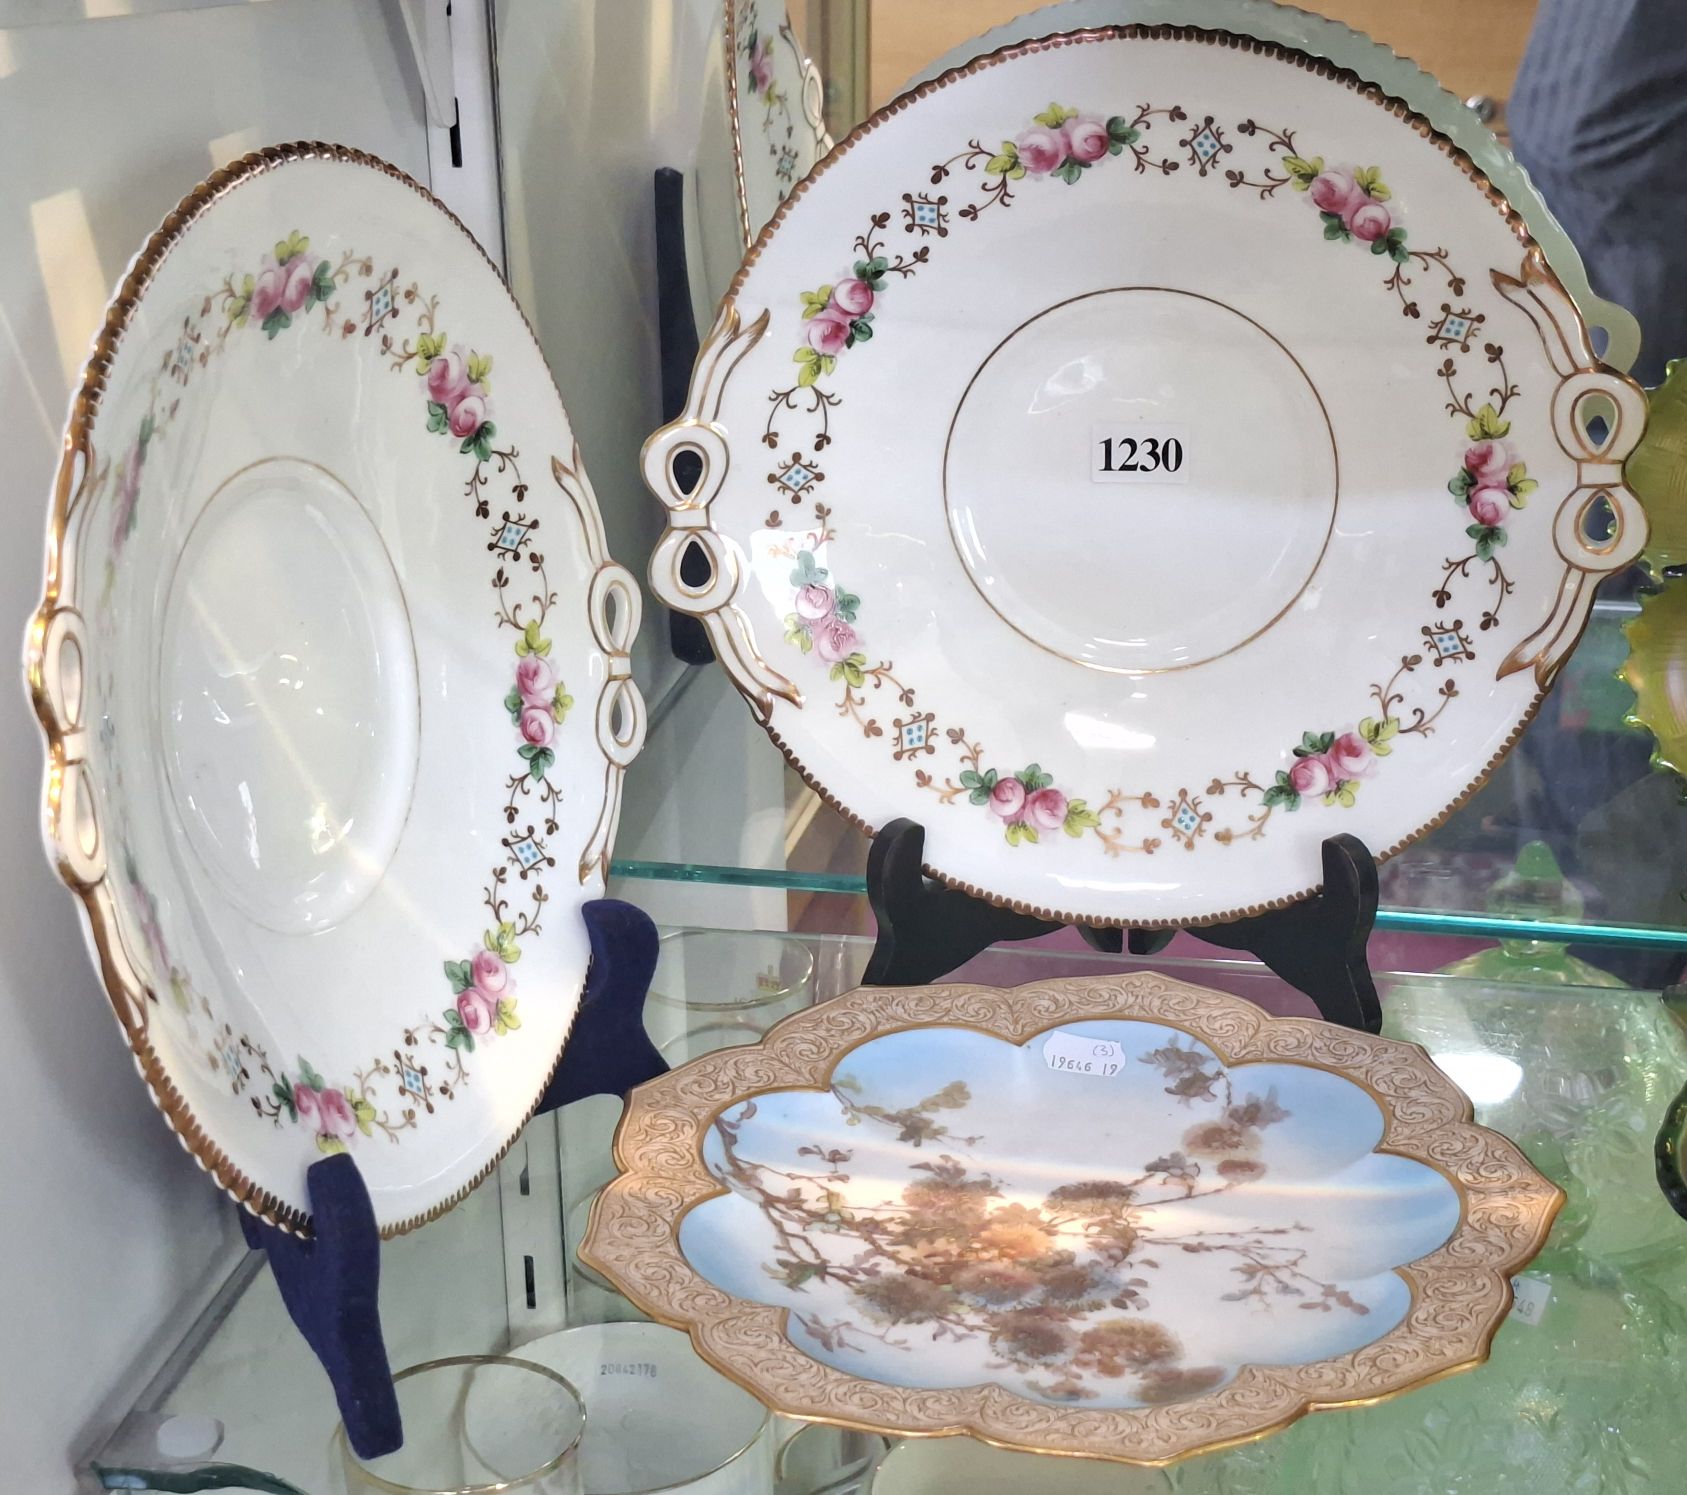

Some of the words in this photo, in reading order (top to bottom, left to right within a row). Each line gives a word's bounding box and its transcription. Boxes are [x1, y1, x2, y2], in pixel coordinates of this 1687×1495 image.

[1098, 437, 1183, 473] 1230
[1092, 1044, 1115, 1057] (3)
[1051, 1054, 1093, 1072] 19646
[1102, 1063, 1118, 1076] 19
